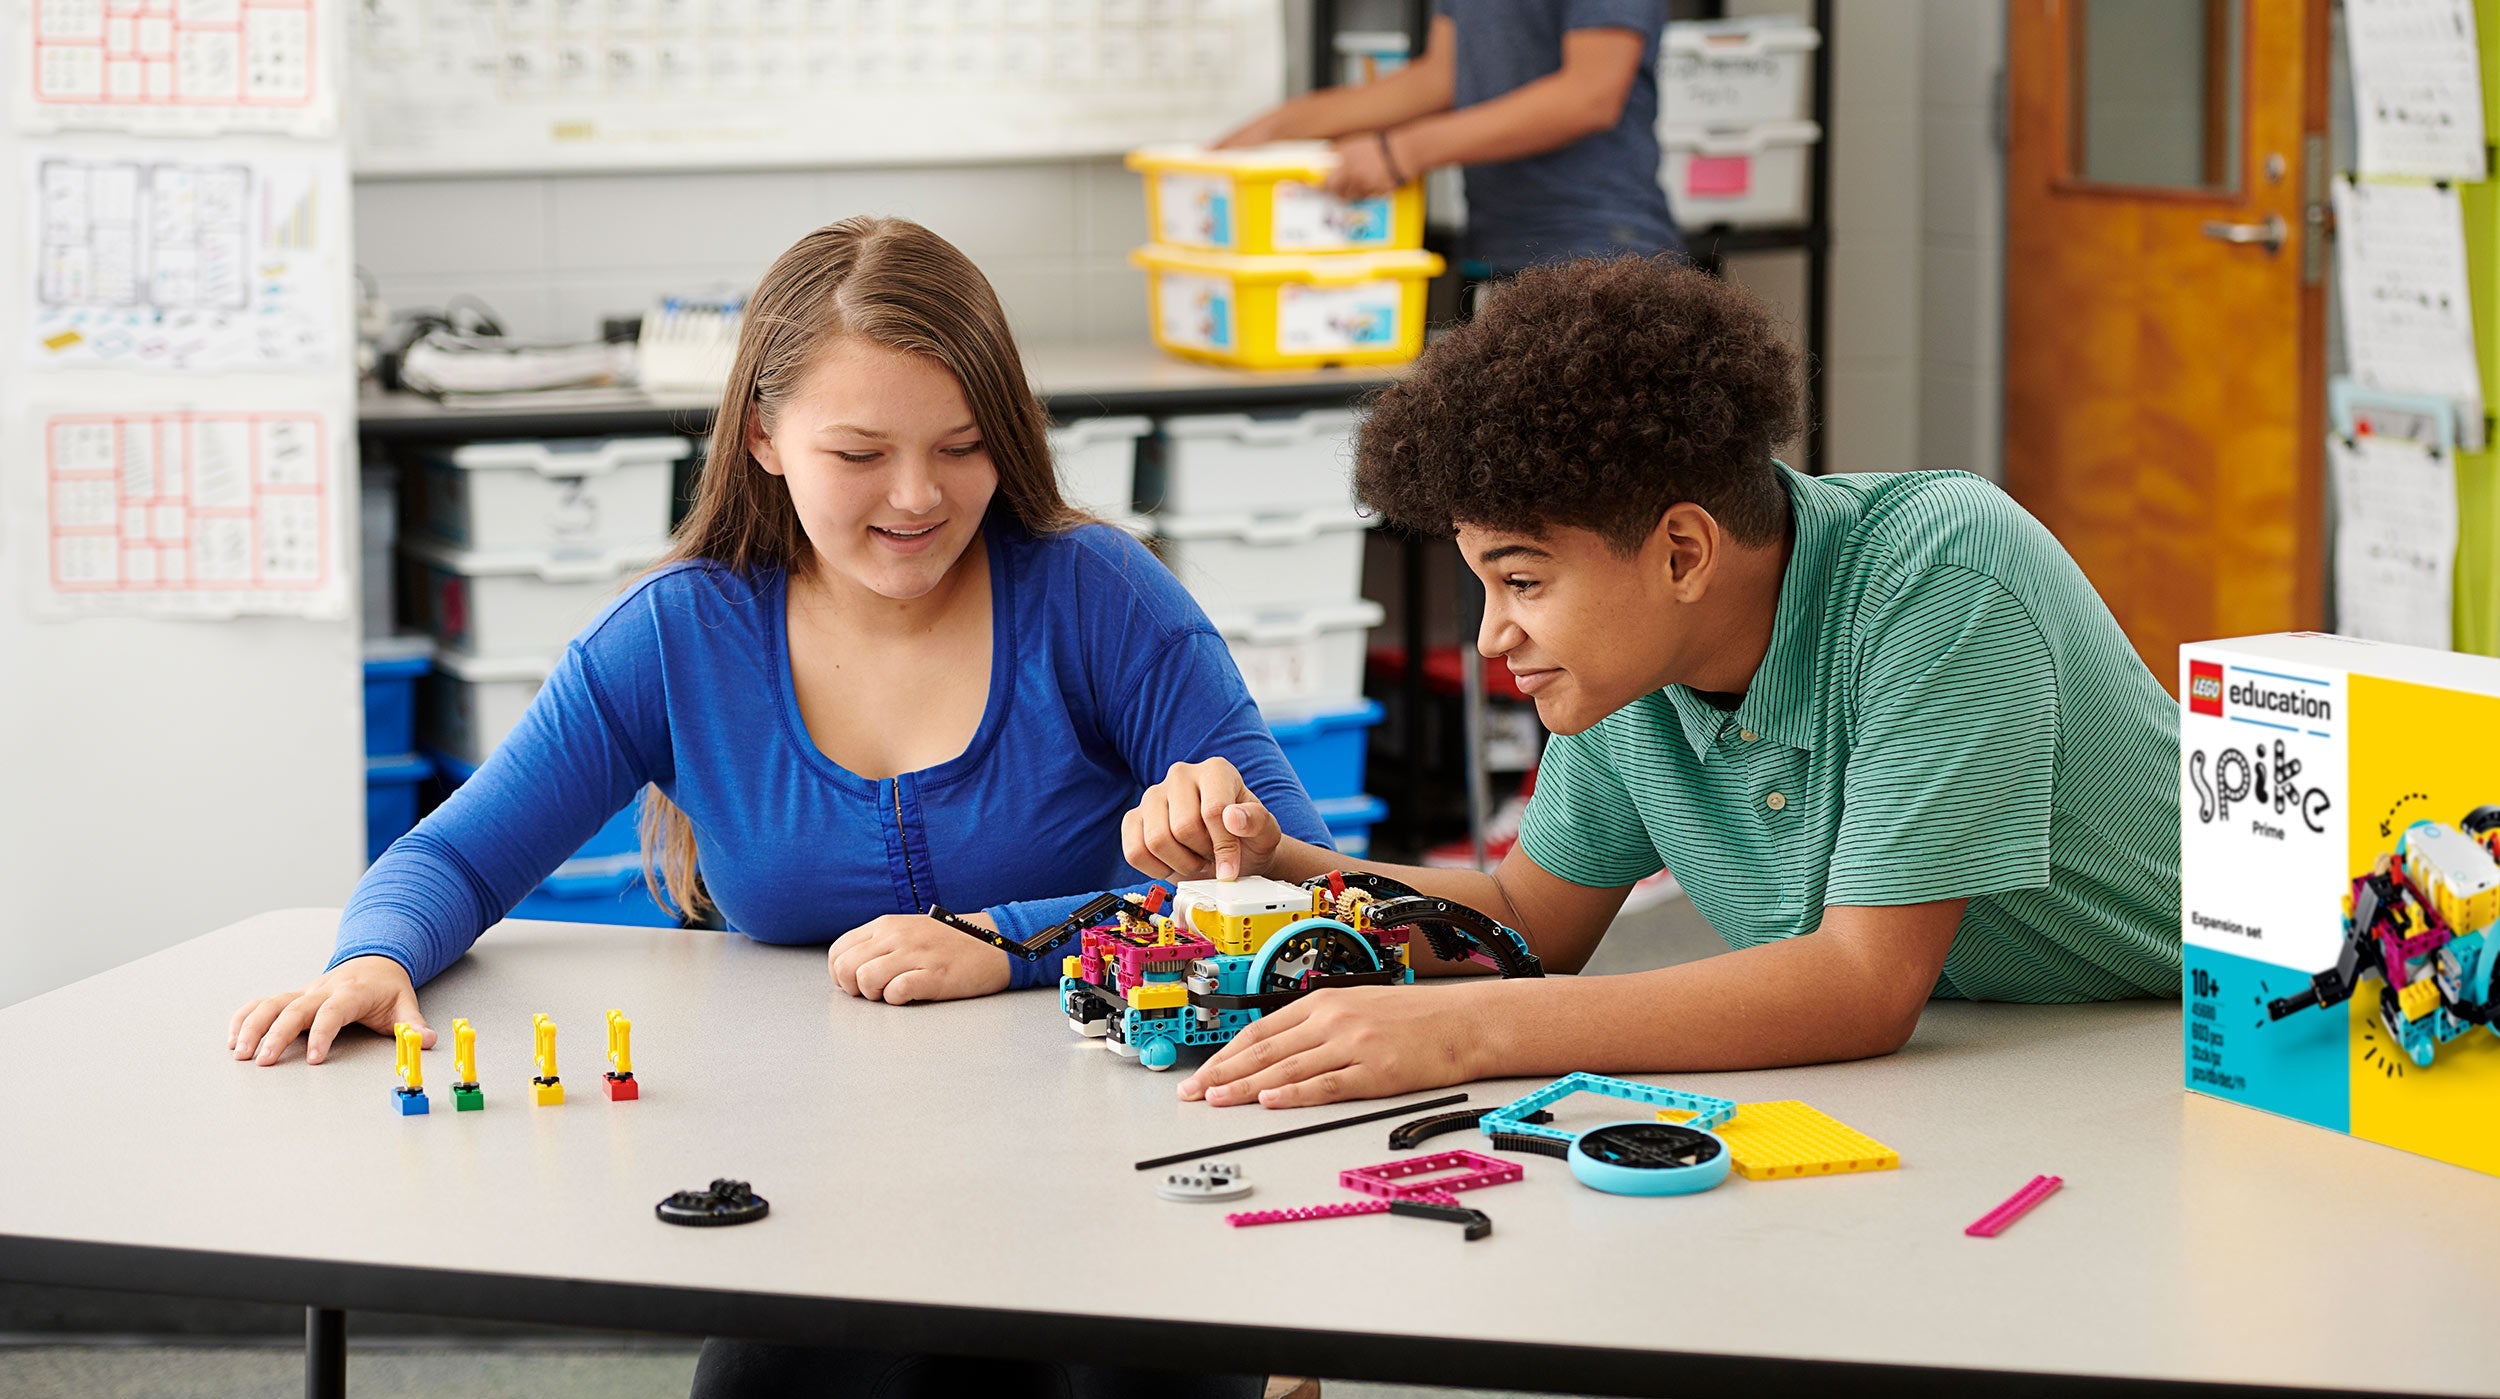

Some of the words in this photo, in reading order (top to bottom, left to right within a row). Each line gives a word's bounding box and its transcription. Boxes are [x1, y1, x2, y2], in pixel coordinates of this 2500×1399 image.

[2192, 676, 2221, 700] LEGO
[2229, 680, 2331, 720] education
[2252, 820, 2285, 841] Prime
[2191, 911, 2243, 935] Expansion
[2246, 926, 2262, 940] set
[2191, 968, 2219, 998] 10+
